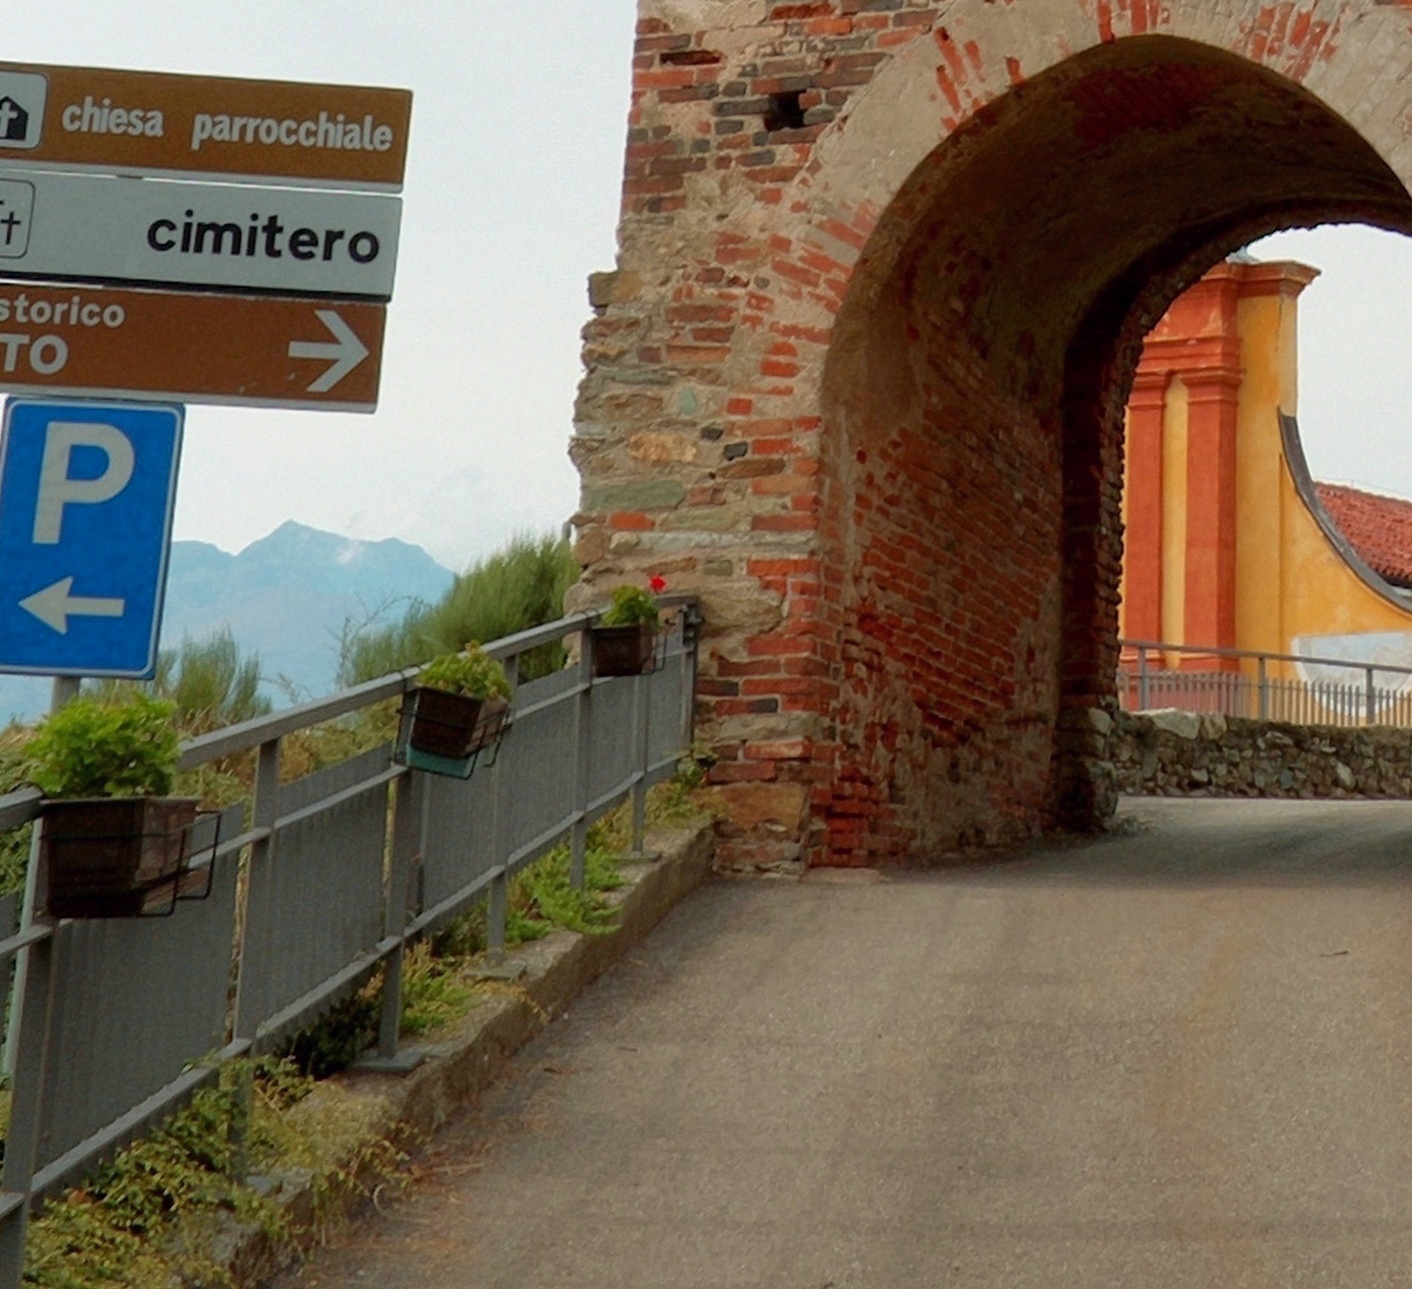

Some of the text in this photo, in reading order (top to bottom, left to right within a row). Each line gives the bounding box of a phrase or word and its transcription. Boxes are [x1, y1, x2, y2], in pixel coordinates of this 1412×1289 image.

[62, 96, 393, 152] chiesa parrocchiale
[147, 209, 380, 263] cimitero
[32, 421, 135, 545] P
